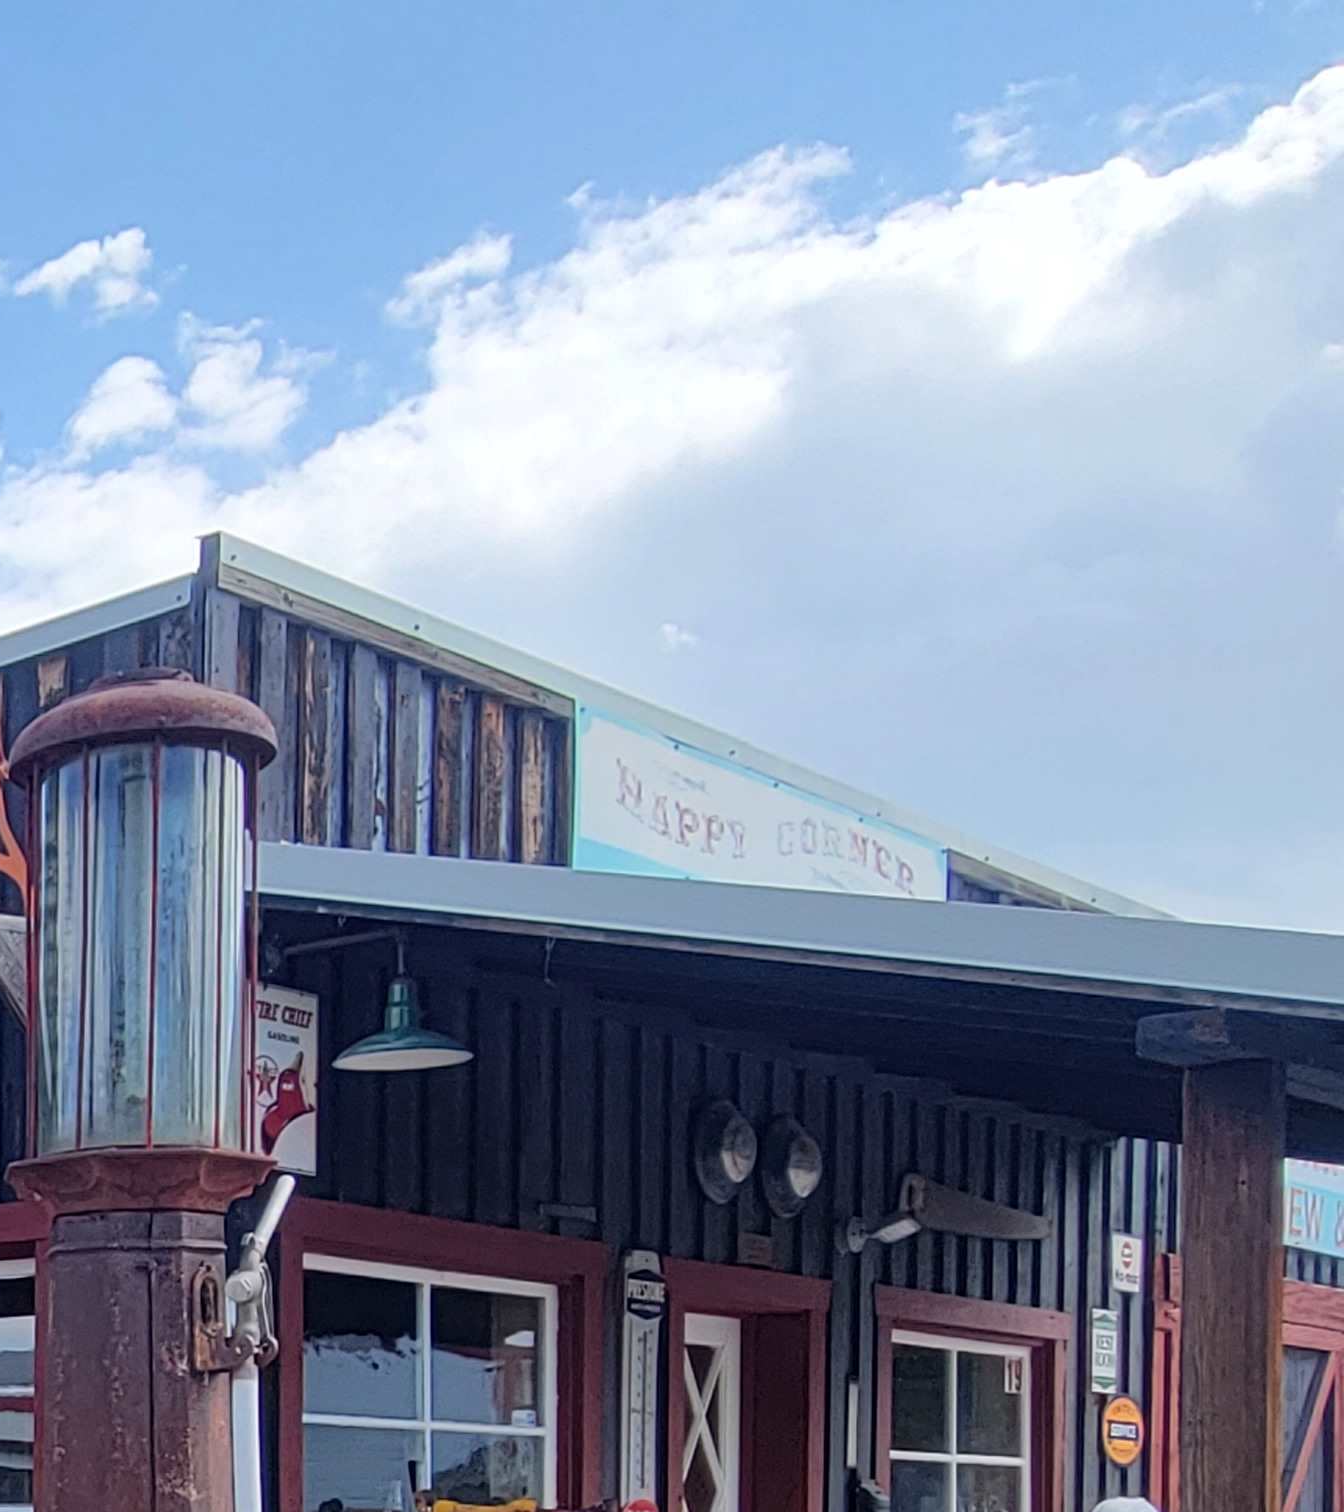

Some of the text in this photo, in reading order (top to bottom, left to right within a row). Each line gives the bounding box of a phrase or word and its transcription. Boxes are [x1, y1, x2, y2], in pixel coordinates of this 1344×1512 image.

[616, 758, 915, 895] HAPPY CORNER
[282, 1006, 313, 1028] CHIEF
[1289, 1187, 1324, 1241] EW
